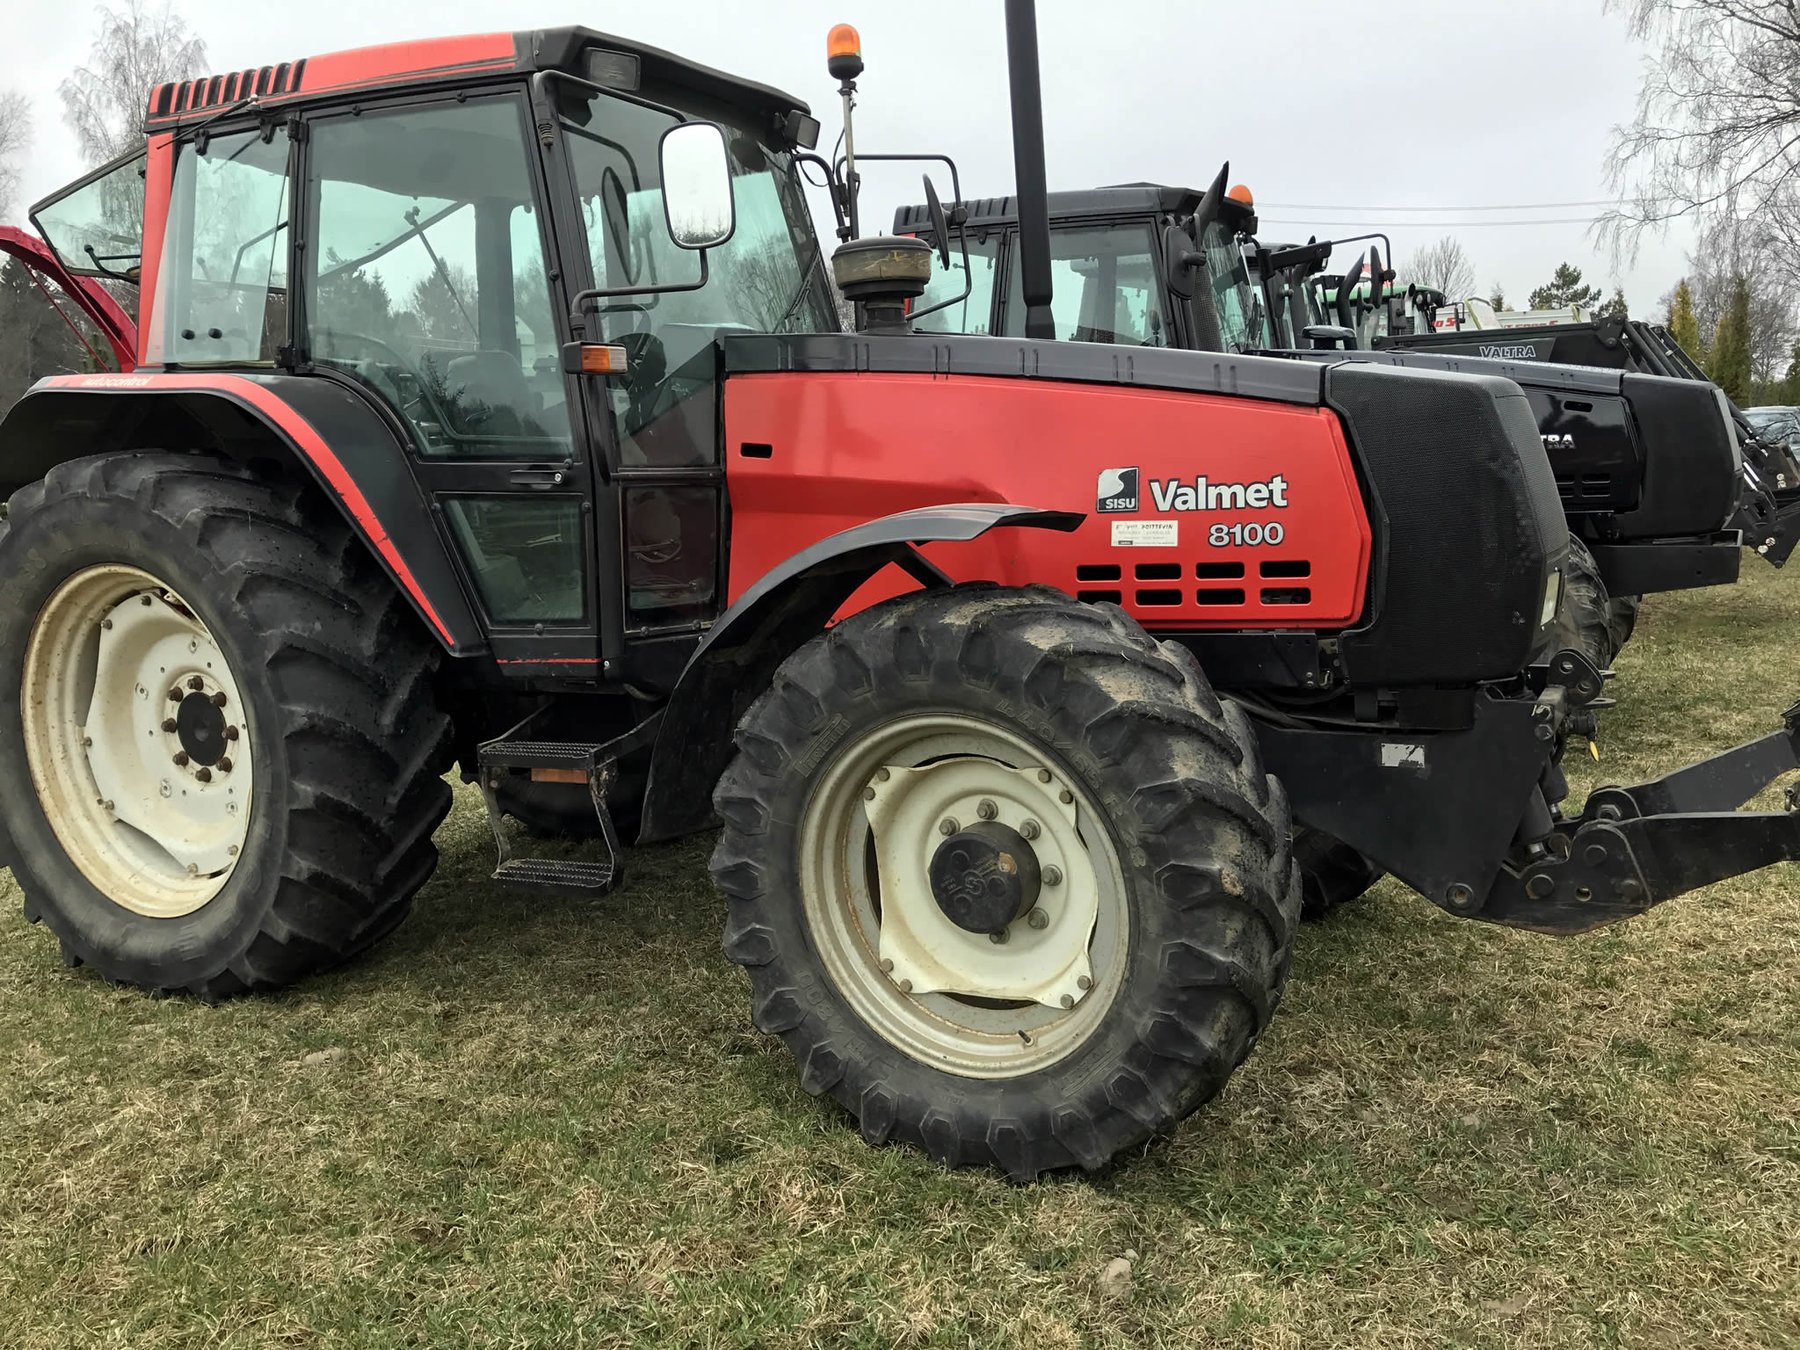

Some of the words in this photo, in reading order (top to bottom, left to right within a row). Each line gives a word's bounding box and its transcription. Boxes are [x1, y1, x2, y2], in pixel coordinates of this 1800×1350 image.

[1479, 345, 1536, 359] VALTRA
[81, 375, 153, 387] autocontrol
[1149, 473, 1289, 512] Valmet
[1105, 497, 1136, 509] SISU
[1208, 521, 1286, 547] 8100
